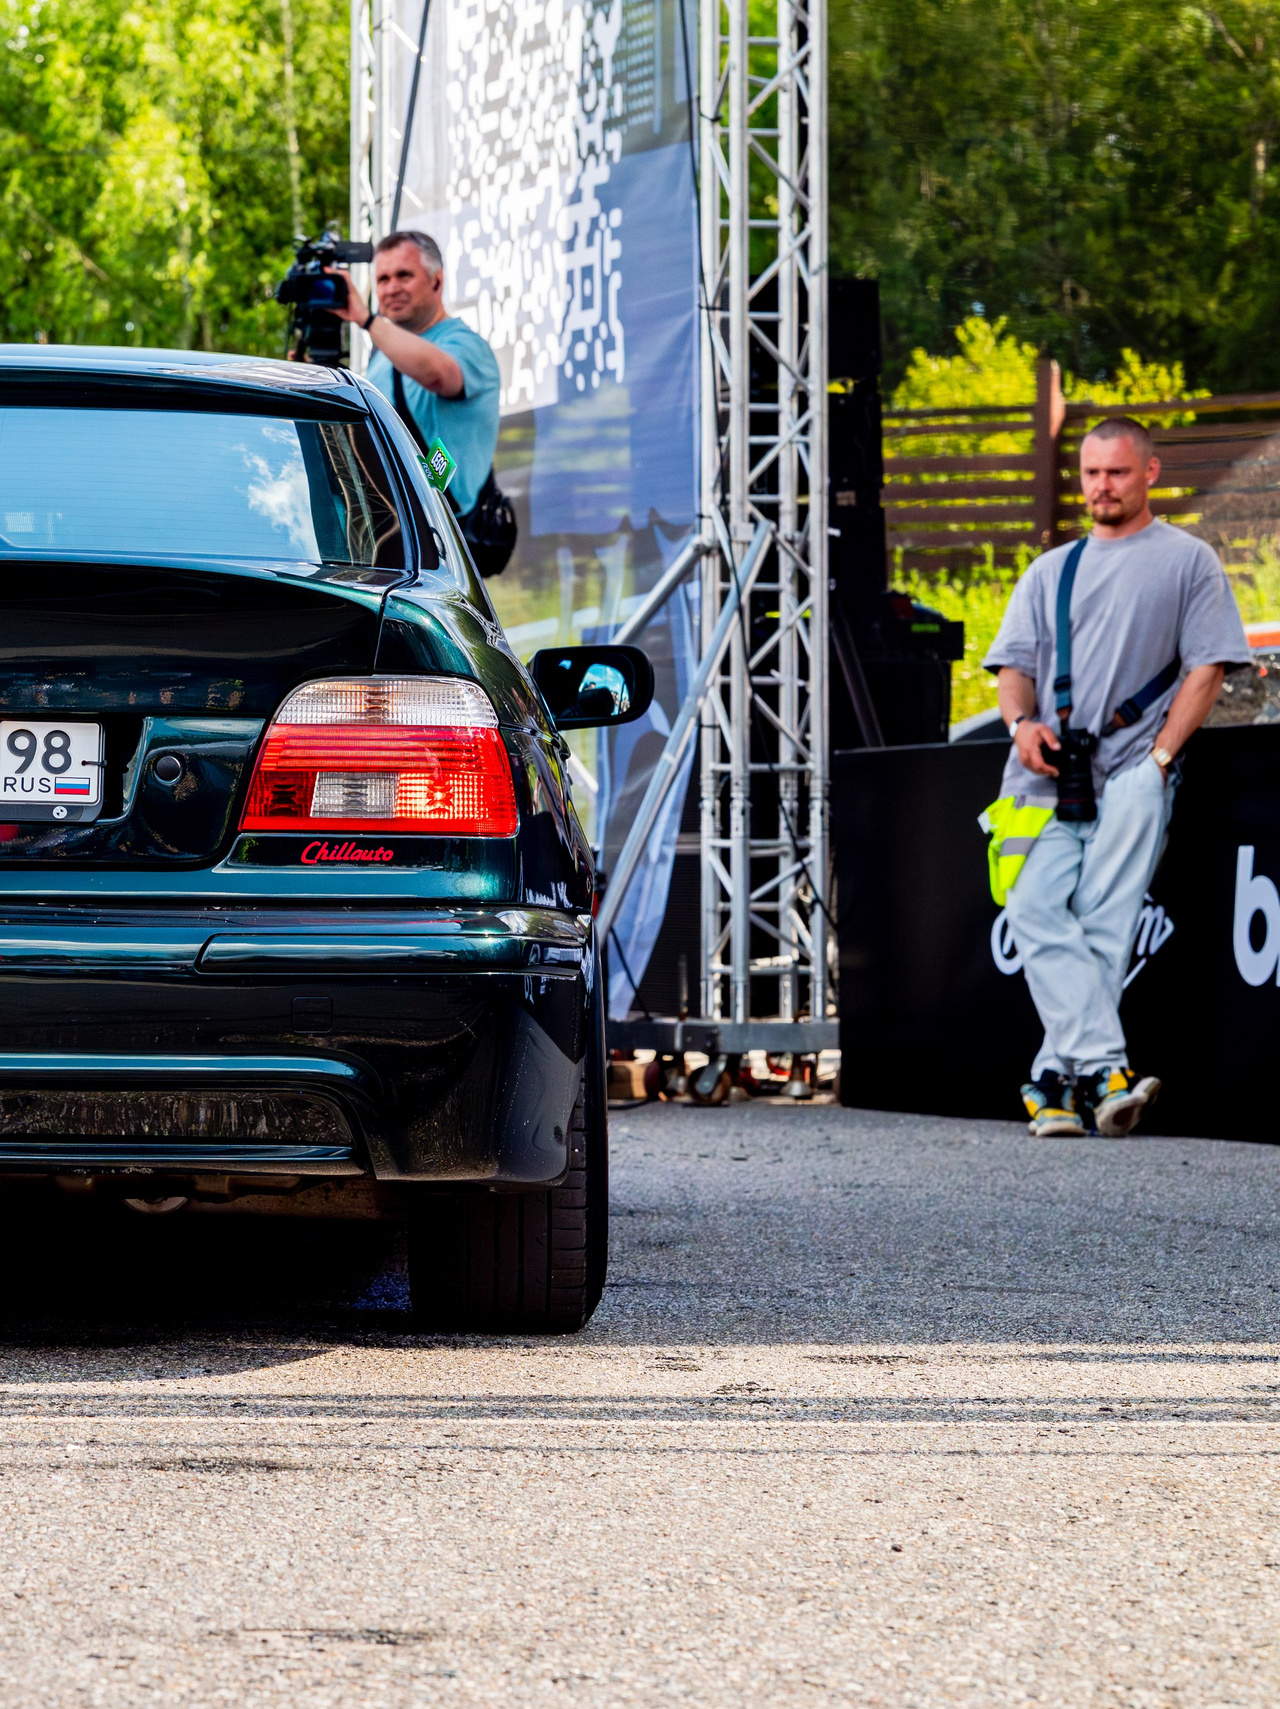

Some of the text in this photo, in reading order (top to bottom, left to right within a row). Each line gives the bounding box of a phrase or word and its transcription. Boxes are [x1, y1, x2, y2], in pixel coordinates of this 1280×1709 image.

[430, 449, 448, 477] LEGO
[6, 728, 72, 775] 98
[3, 776, 52, 793] RUS
[300, 840, 394, 865] Chillauto
[1232, 844, 1280, 988] b
